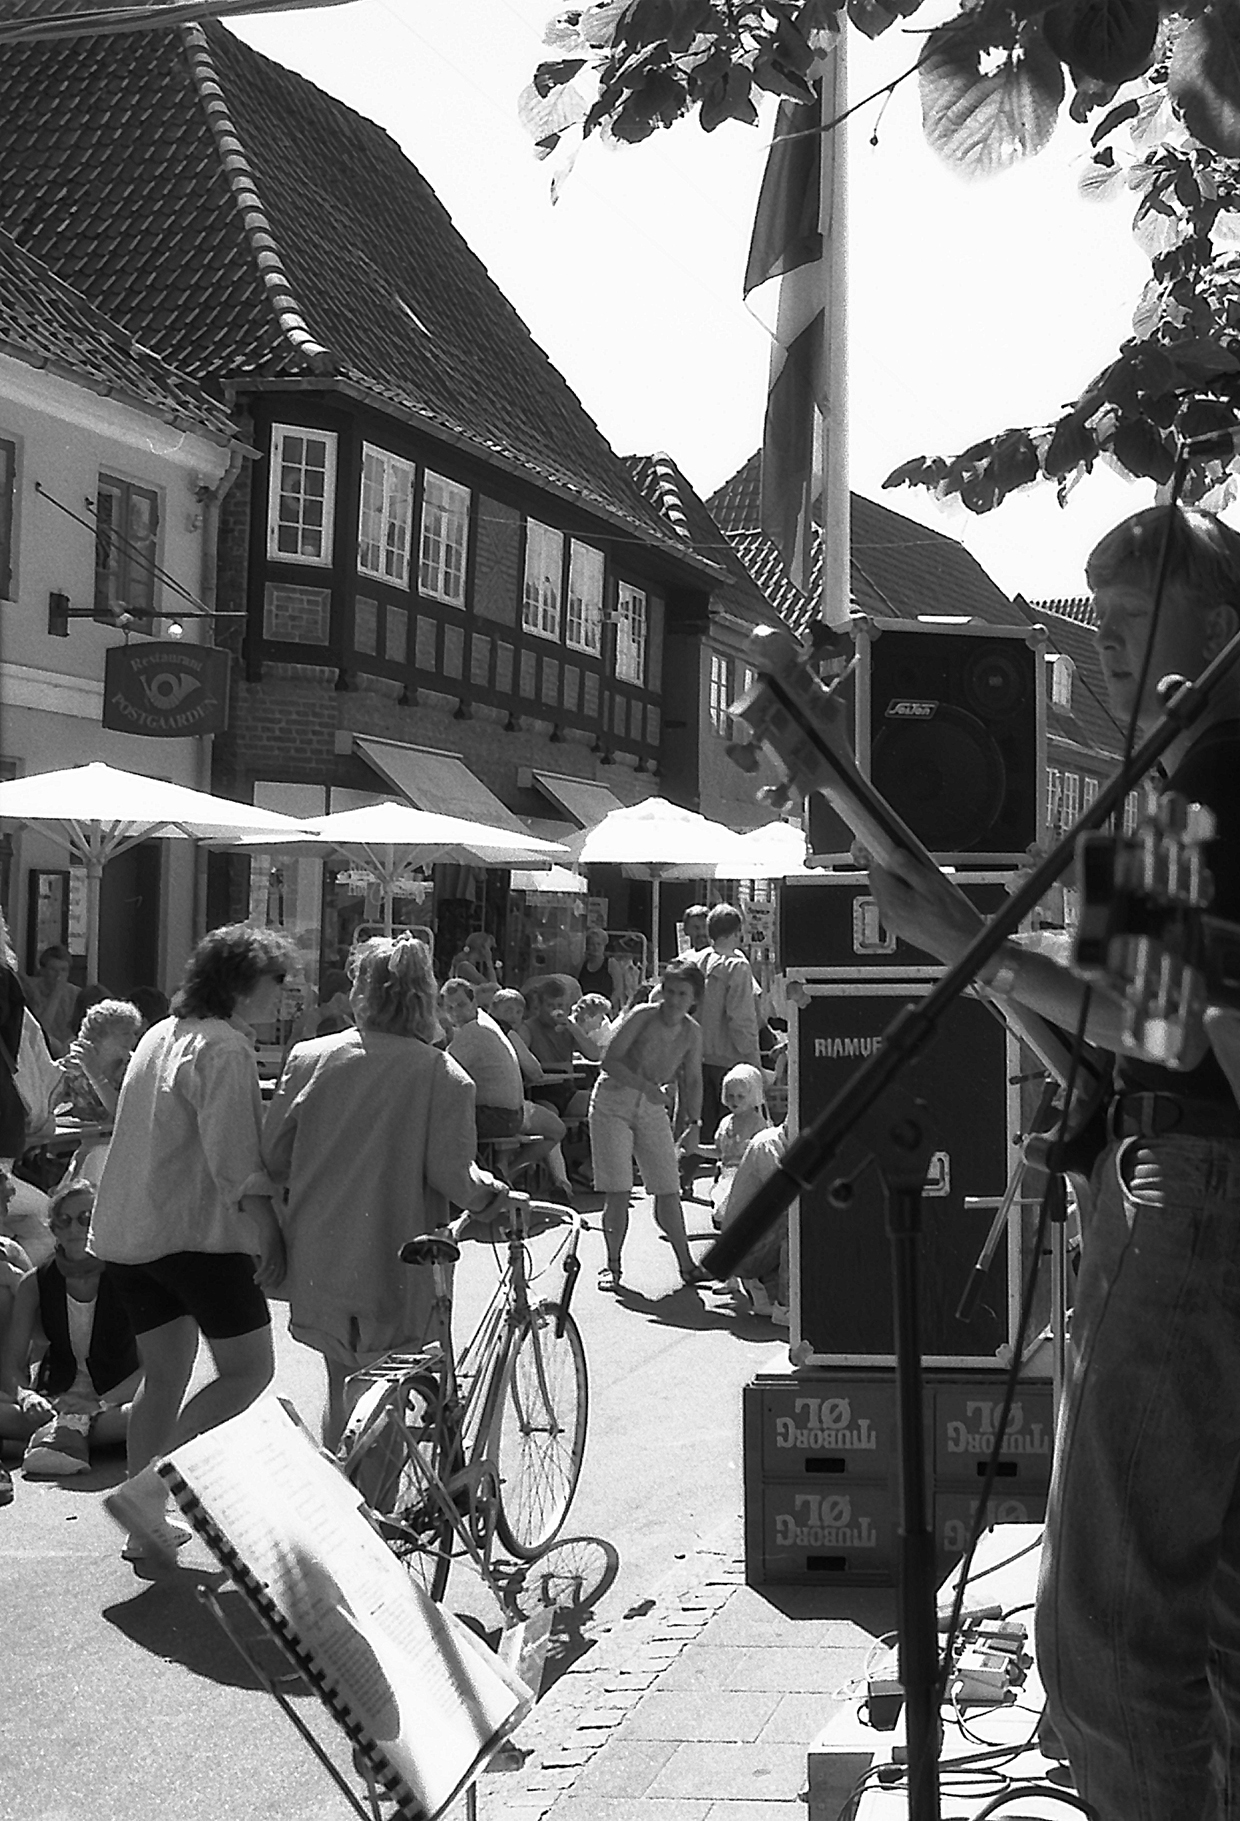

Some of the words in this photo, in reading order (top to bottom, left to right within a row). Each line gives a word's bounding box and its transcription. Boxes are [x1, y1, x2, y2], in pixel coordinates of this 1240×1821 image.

[111, 692, 218, 729] POSTGAARDEN
[795, 1398, 851, 1429] ØL
[776, 1417, 876, 1449] TUBORG
[795, 1494, 851, 1527] ØL
[776, 1514, 876, 1547] TUBORG
